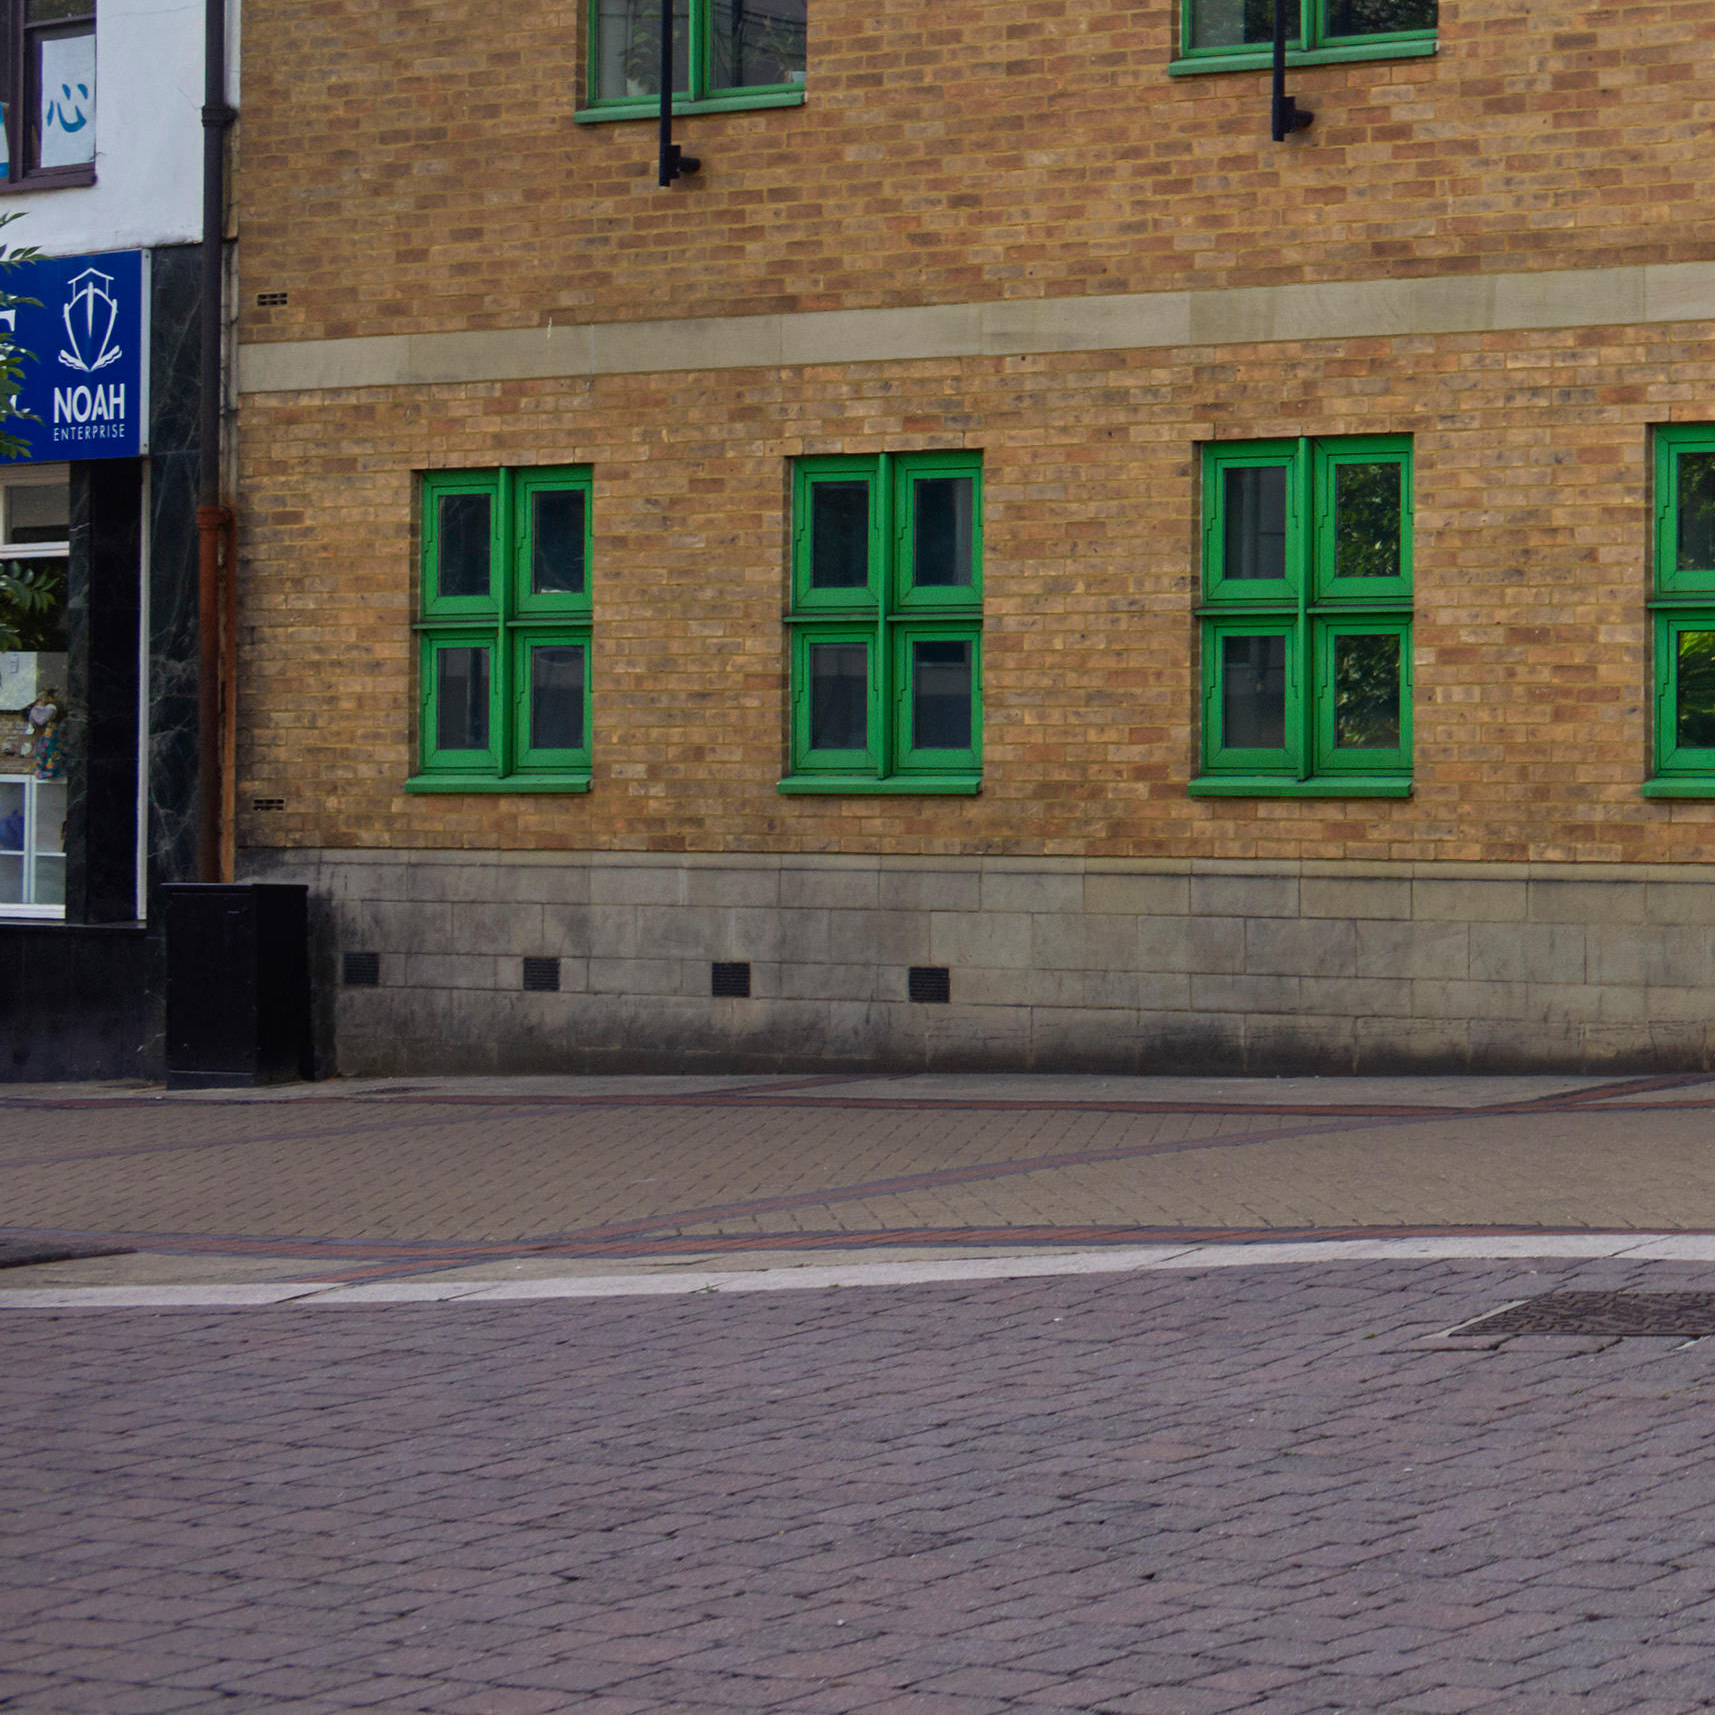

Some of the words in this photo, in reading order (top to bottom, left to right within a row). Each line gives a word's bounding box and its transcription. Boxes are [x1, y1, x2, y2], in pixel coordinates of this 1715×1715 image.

[46, 83, 89, 134] 心
[53, 382, 126, 424] NOAH
[53, 423, 126, 442] ENTERPRISE
